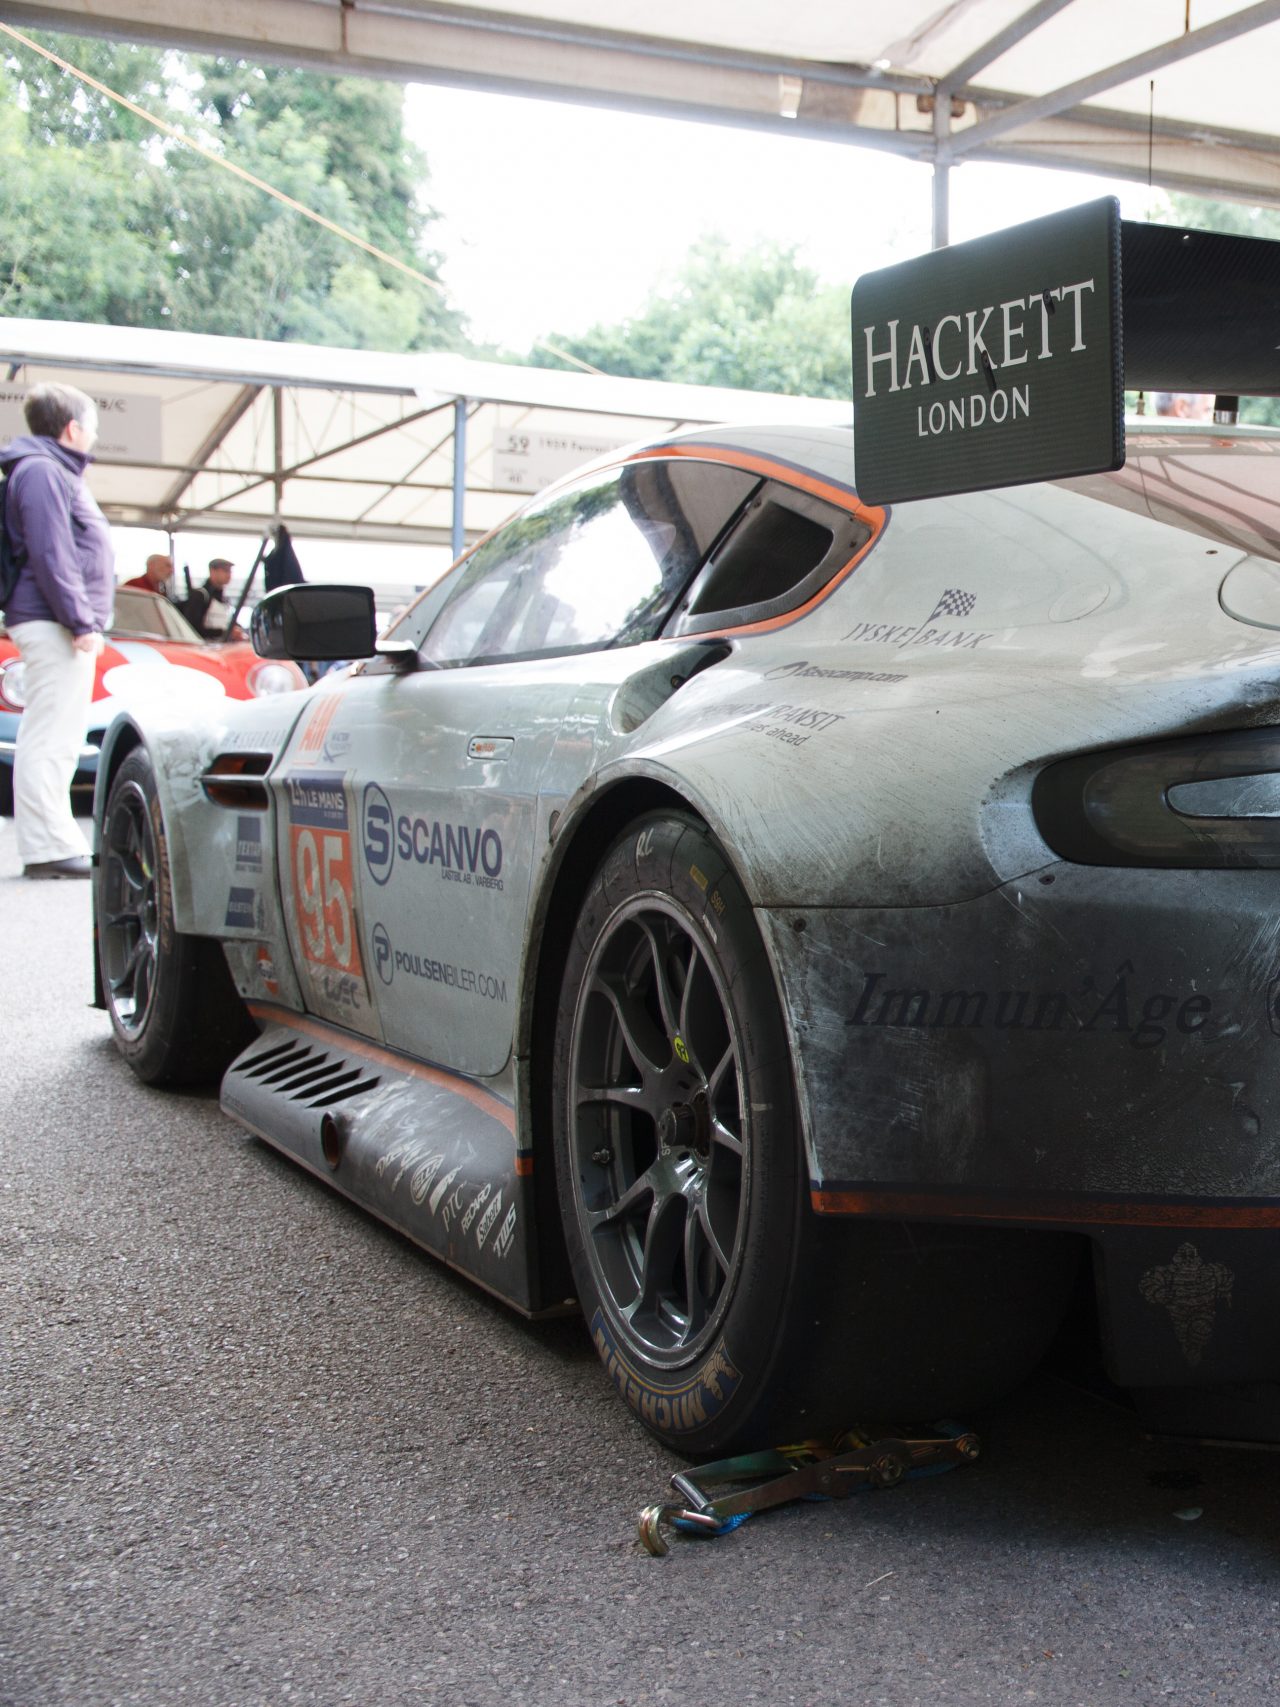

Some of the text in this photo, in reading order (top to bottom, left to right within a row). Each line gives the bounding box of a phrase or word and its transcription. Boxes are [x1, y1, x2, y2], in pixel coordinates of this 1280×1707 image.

[863, 278, 1095, 398] HACKETT
[917, 384, 1031, 437] LONDON
[840, 622, 994, 649] JYSKE BANK
[764, 703, 846, 732] RANSIT
[765, 723, 812, 746] ahead
[397, 815, 503, 878] SCANVO
[296, 829, 352, 968] 95
[460, 1182, 492, 1236] RECARO
